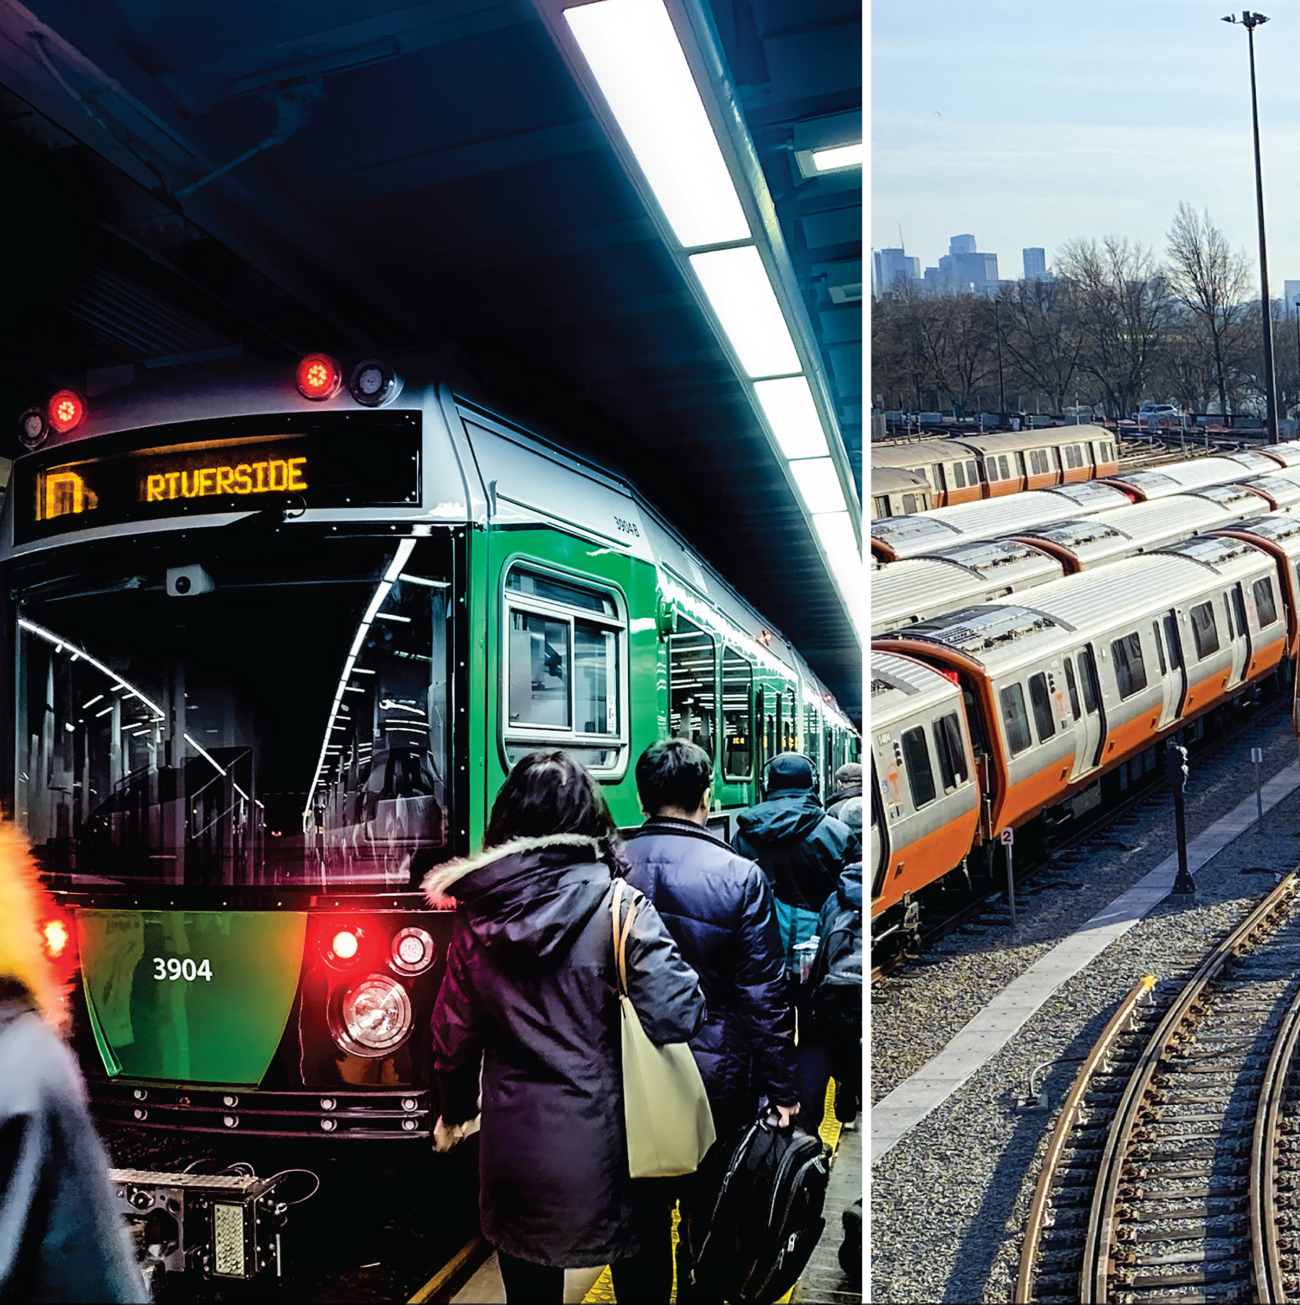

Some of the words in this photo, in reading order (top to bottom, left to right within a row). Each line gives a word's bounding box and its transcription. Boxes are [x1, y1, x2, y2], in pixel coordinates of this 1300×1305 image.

[146, 456, 308, 502] RIVERSIDE
[1003, 830, 1011, 842] 2
[153, 957, 213, 982] 3904
